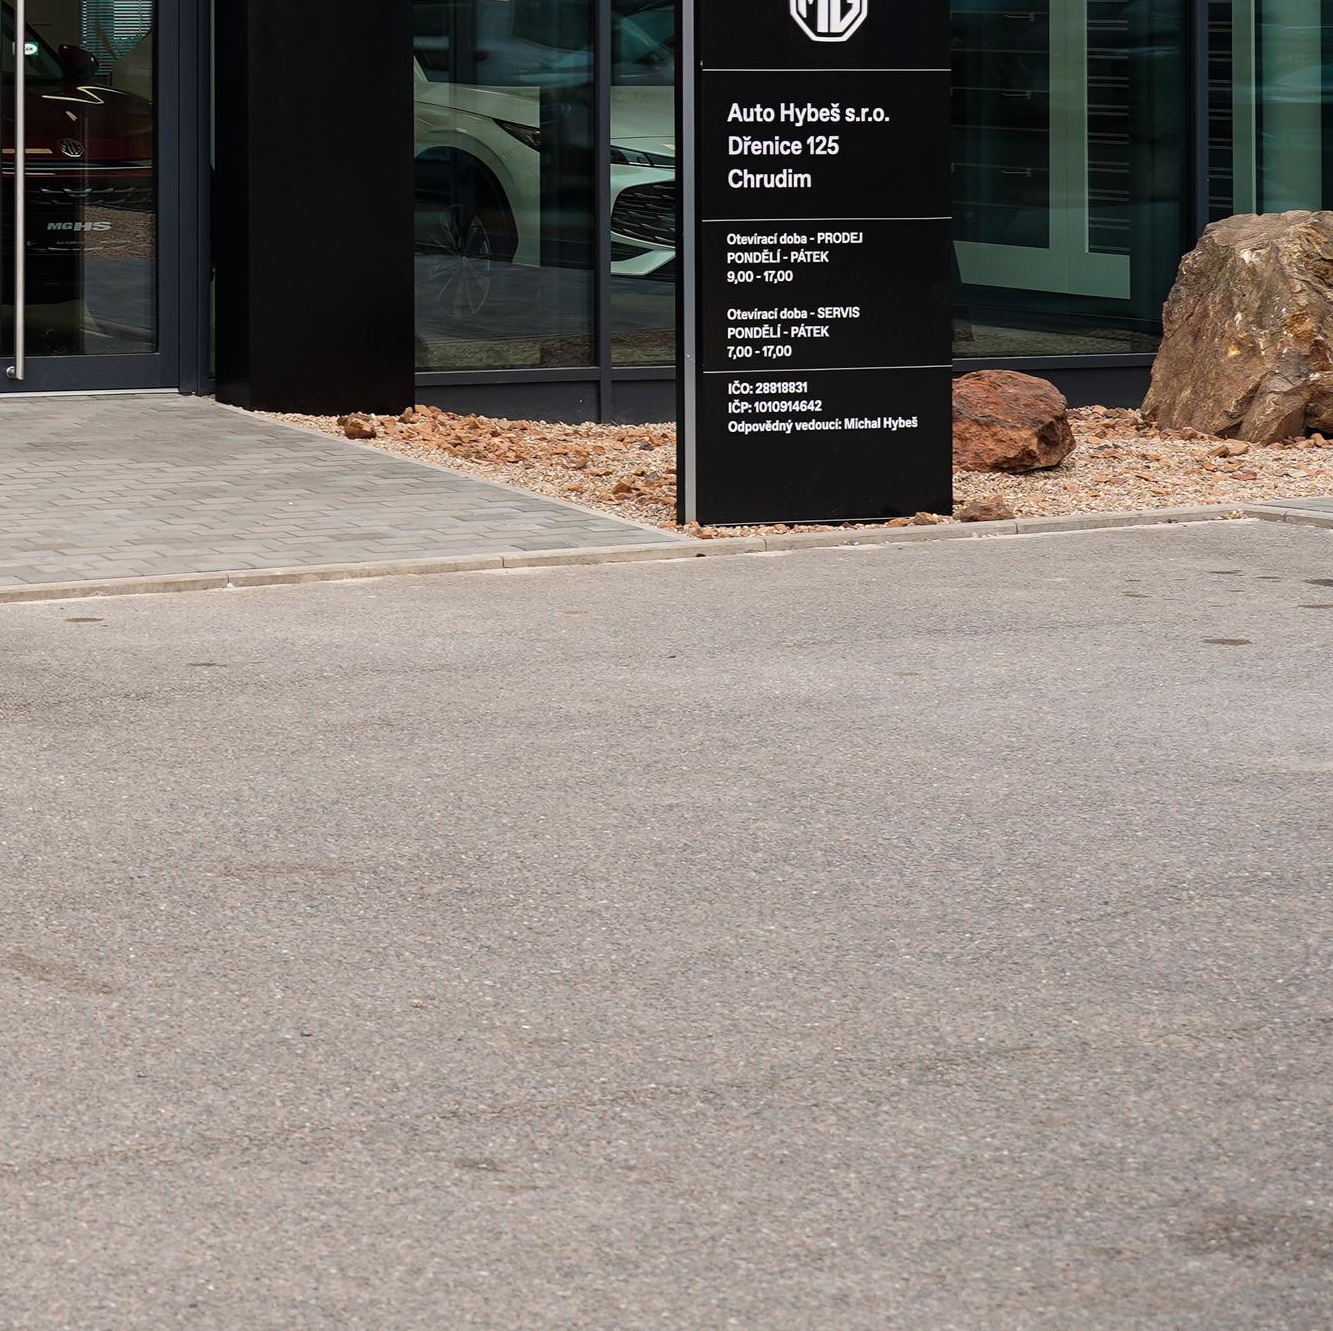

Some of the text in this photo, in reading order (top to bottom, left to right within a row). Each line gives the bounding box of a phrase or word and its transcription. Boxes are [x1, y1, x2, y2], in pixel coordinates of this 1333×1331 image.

[727, 102, 890, 127] Auto Hybeš s.r.o.
[728, 135, 840, 156] Dřenice 125
[728, 168, 812, 189] Chrudim
[727, 232, 777, 245] Otevírací
[779, 232, 808, 244] doba
[818, 232, 863, 244] PRODEJ
[727, 248, 781, 264] PONDĚLÍ
[790, 247, 830, 263] PÁTEK
[727, 270, 754, 285] 9,00
[763, 269, 794, 284] 17,00
[727, 307, 777, 321] Otevírací
[779, 307, 808, 320] doba
[818, 306, 861, 319] SERVIS
[727, 323, 781, 339] PONDĚLÍ
[790, 323, 830, 338] PÁTEK
[727, 345, 753, 360] 7,00
[762, 344, 793, 360] 17,00
[728, 380, 808, 395] IČO: 28818831
[728, 398, 823, 413] IČP: 1010914642
[728, 418, 793, 435] Odpovědný
[844, 416, 882, 430] Michal
[883, 416, 918, 431] Hybeš
